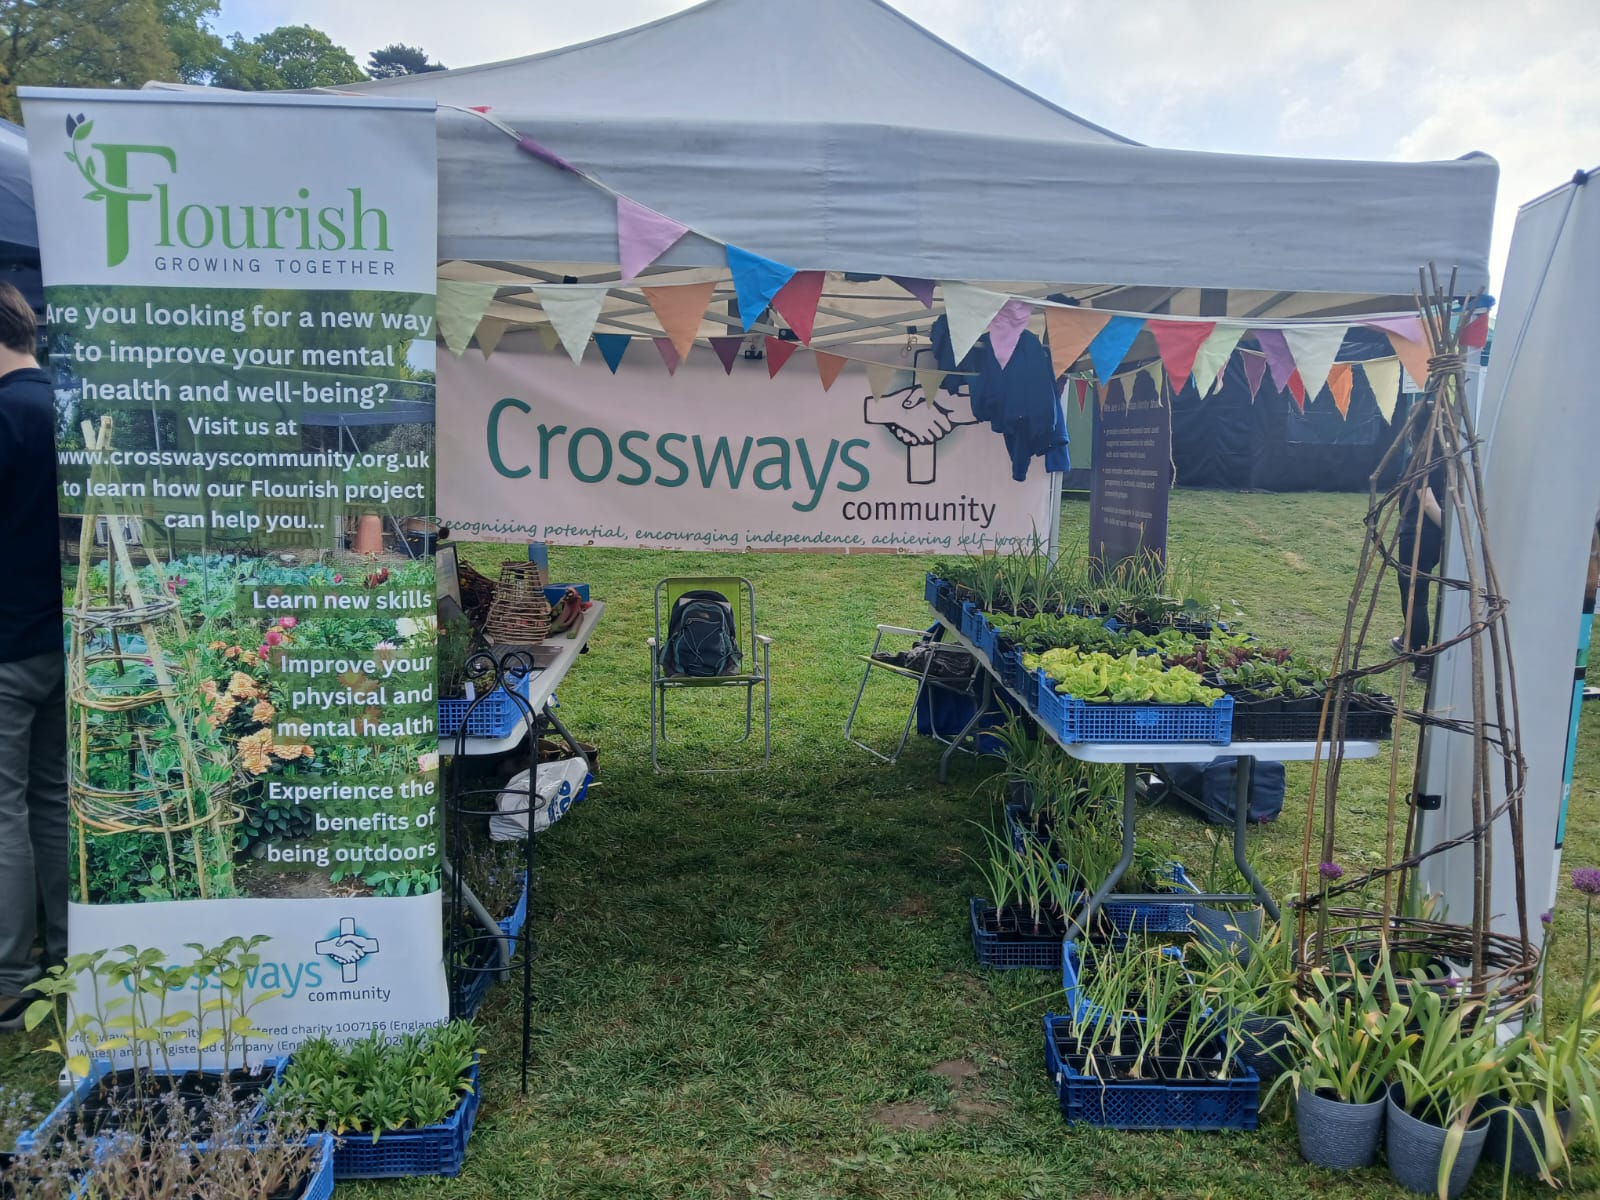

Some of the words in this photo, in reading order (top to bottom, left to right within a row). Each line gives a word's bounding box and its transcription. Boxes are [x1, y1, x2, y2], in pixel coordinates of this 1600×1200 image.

[91, 143, 394, 268] Flourish
[154, 256, 260, 273] GROWING
[276, 259, 395, 276] TOGETHER
[46, 303, 78, 325] Are
[85, 306, 136, 329] you
[145, 304, 246, 332] looking
[252, 305, 292, 327] for
[299, 310, 314, 328] a
[321, 310, 372, 329] new
[382, 312, 433, 337] way
[74, 341, 101, 362] to
[110, 340, 226, 369] improve
[232, 349, 295, 371] your
[302, 345, 395, 367] mental
[82, 378, 171, 401] health
[179, 381, 229, 402] and
[236, 381, 389, 409] well-being?
[188, 416, 239, 436] Visit
[248, 421, 269, 436] us
[275, 418, 298, 436] at
[57, 450, 430, 472] www.crosswayscommunity.org.uk
[487, 398, 870, 511] Crossways
[62, 480, 81, 497] to
[86, 478, 146, 497] learn
[153, 478, 201, 497] how
[206, 483, 245, 497] our
[251, 480, 339, 499] Flourish
[345, 482, 425, 504] project
[164, 514, 205, 528] can
[211, 510, 260, 533] help
[266, 515, 325, 531] you...
[843, 495, 996, 529] community
[433, 516, 537, 537] Recognising
[543, 522, 628, 541] potential,
[635, 527, 739, 545] encouraging
[745, 528, 866, 547] independence,
[871, 531, 952, 549] achieving
[252, 590, 317, 609] Learn
[324, 593, 370, 609] new
[376, 590, 432, 609] skills
[281, 655, 376, 678] Improve
[382, 656, 433, 678] your
[292, 686, 386, 709] physical
[393, 683, 433, 704] and
[277, 718, 357, 737] mental
[363, 715, 433, 737] health
[269, 781, 393, 804] Experience
[399, 780, 435, 799] the
[315, 811, 409, 832] benefits
[415, 806, 436, 828] of
[267, 843, 330, 867] being
[335, 843, 436, 862] outdoors
[123, 958, 322, 998] Cssways
[308, 985, 391, 1003] community
[292, 1024, 333, 1036] charity
[336, 1022, 387, 1033] 1007156
[390, 1019, 442, 1034] (England
[155, 1042, 217, 1057] rgisteed
